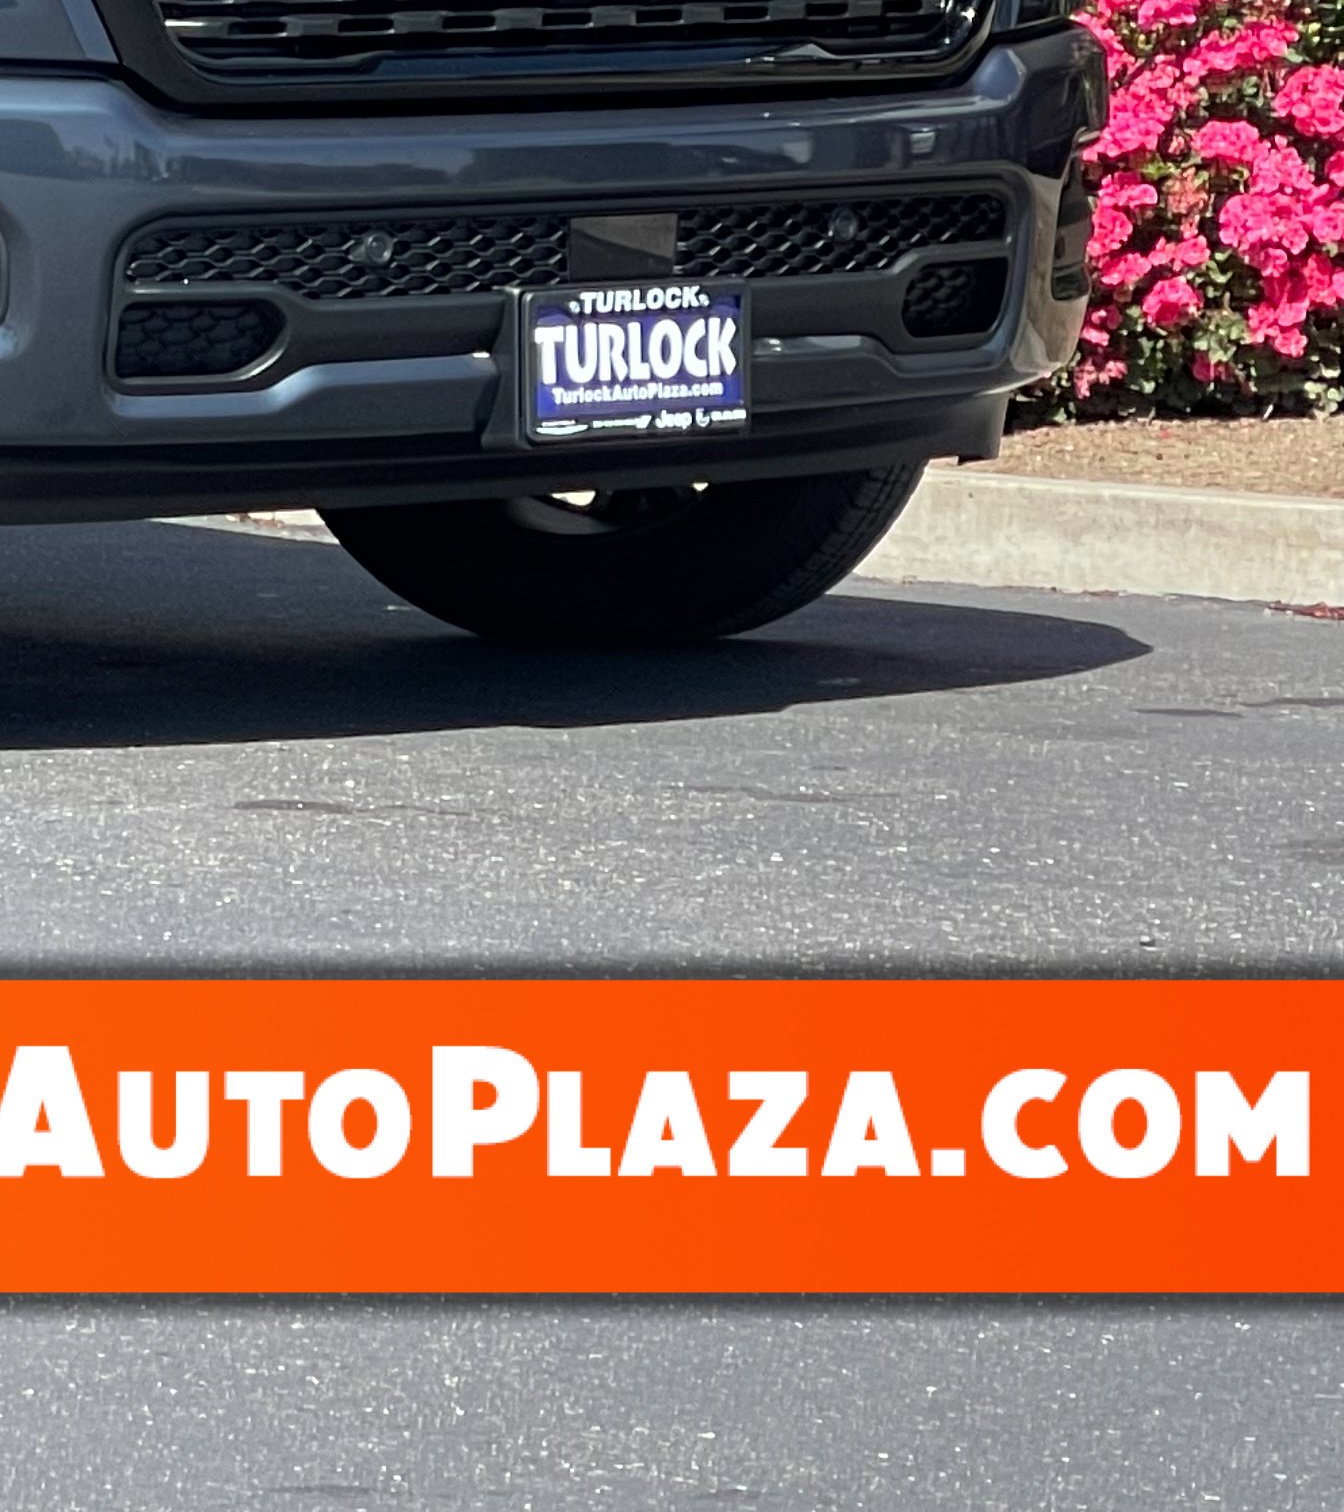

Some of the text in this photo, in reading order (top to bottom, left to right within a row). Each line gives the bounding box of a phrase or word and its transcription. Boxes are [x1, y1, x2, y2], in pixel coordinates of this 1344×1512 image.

[579, 285, 701, 315] TURLOCK
[534, 317, 737, 385] TURLOCK
[551, 382, 724, 405] TurlockAutoPlaza.com
